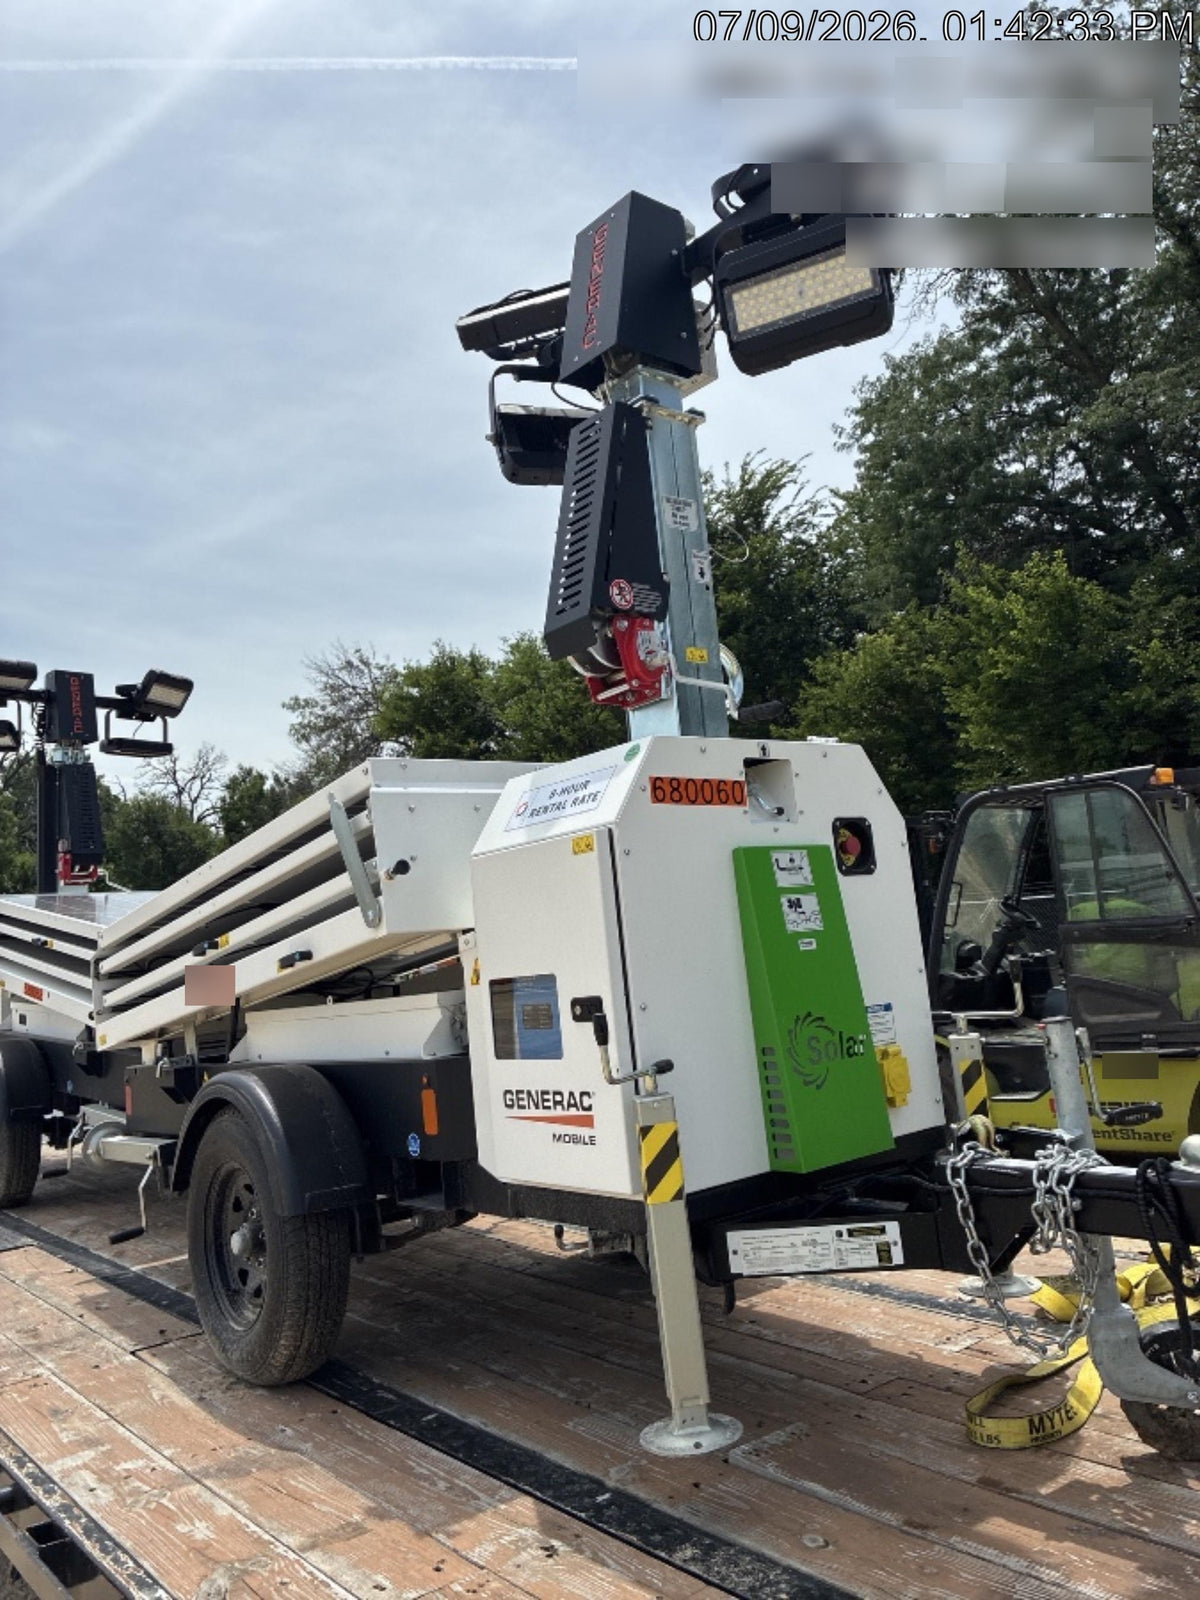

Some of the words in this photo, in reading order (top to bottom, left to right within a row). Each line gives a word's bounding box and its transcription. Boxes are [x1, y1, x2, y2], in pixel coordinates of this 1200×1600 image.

[653, 776, 744, 804] 680060
[528, 799, 568, 818] RENTAL
[570, 790, 601, 808] RATE
[807, 1030, 868, 1066] Solar
[503, 1089, 593, 1112] GENERAC
[552, 1132, 597, 1146] MOBILE
[1092, 1127, 1174, 1143] entShare
